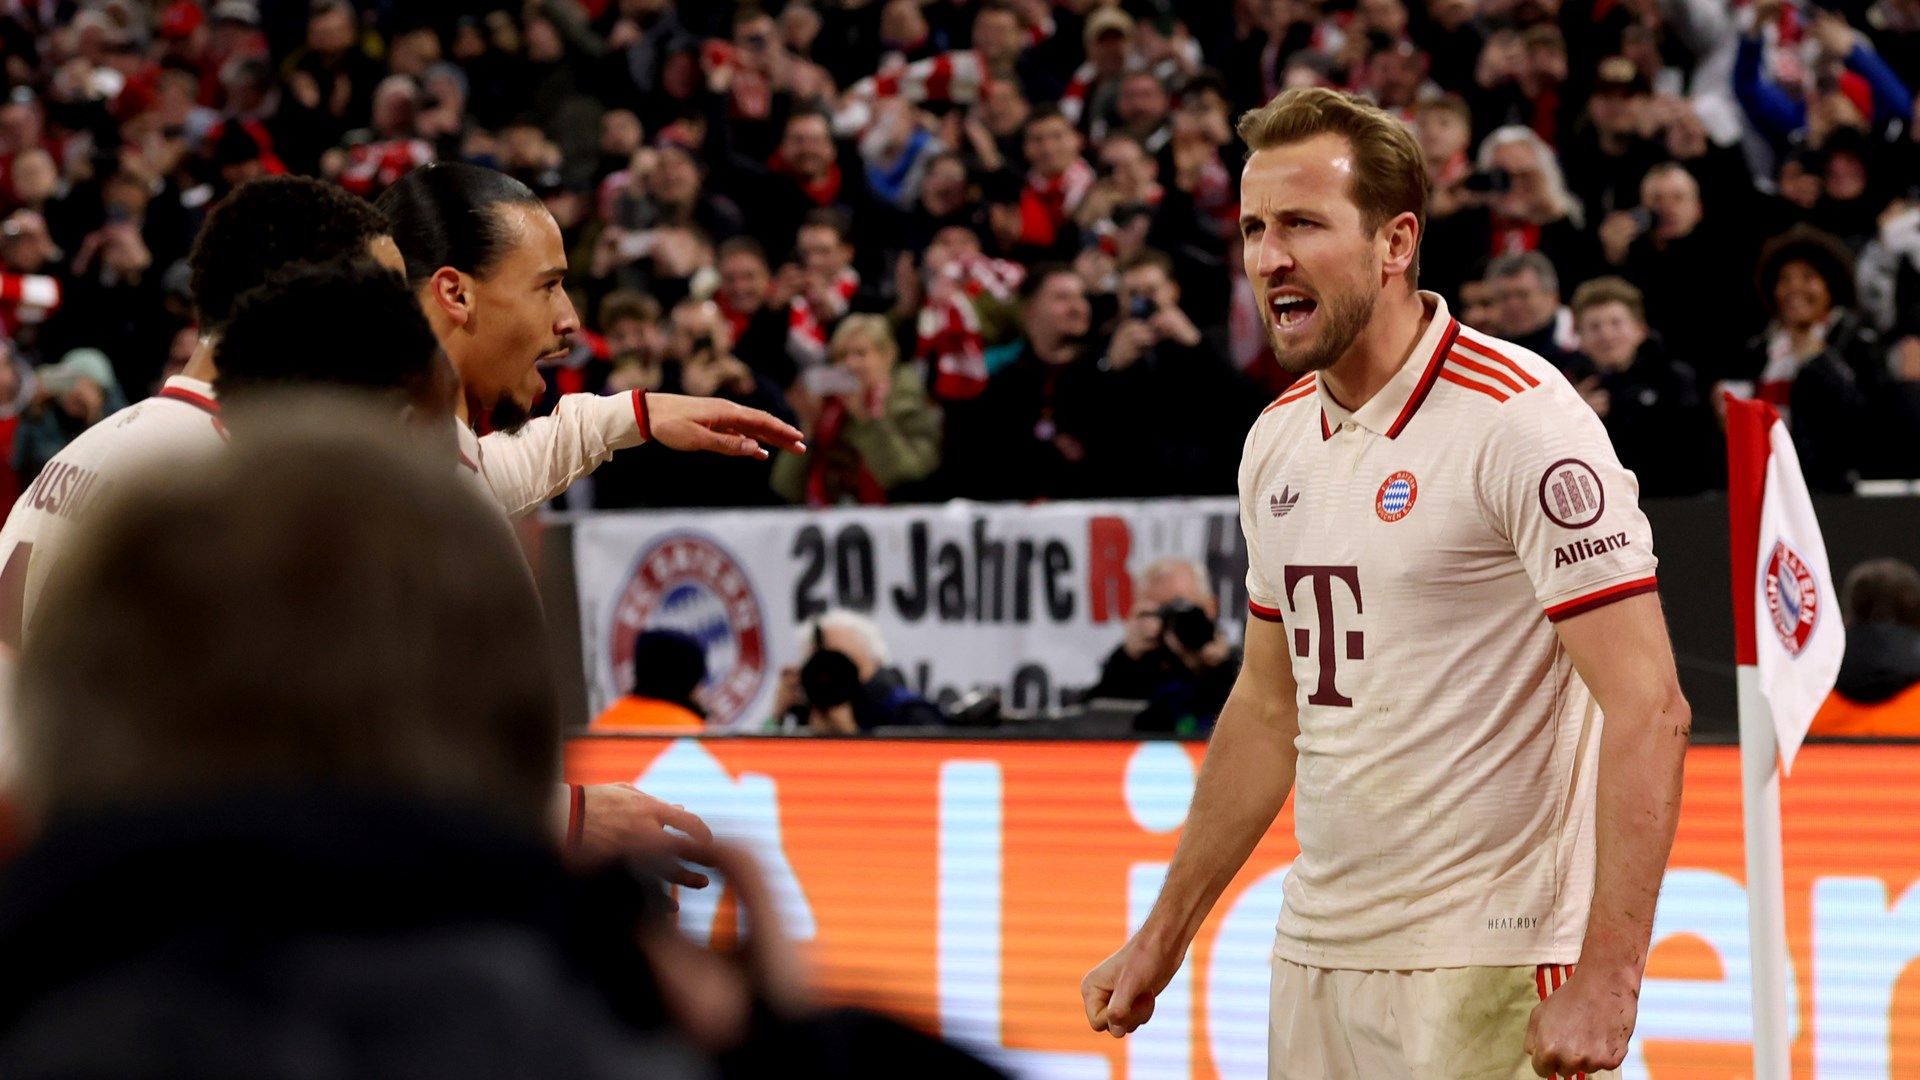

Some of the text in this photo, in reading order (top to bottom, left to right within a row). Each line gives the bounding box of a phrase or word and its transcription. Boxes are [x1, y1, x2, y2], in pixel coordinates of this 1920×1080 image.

[1554, 531, 1630, 569] Allianz
[793, 523, 874, 623] 20
[893, 517, 1074, 622] Jahre
[1488, 917, 1538, 930] HEAT.RDY
